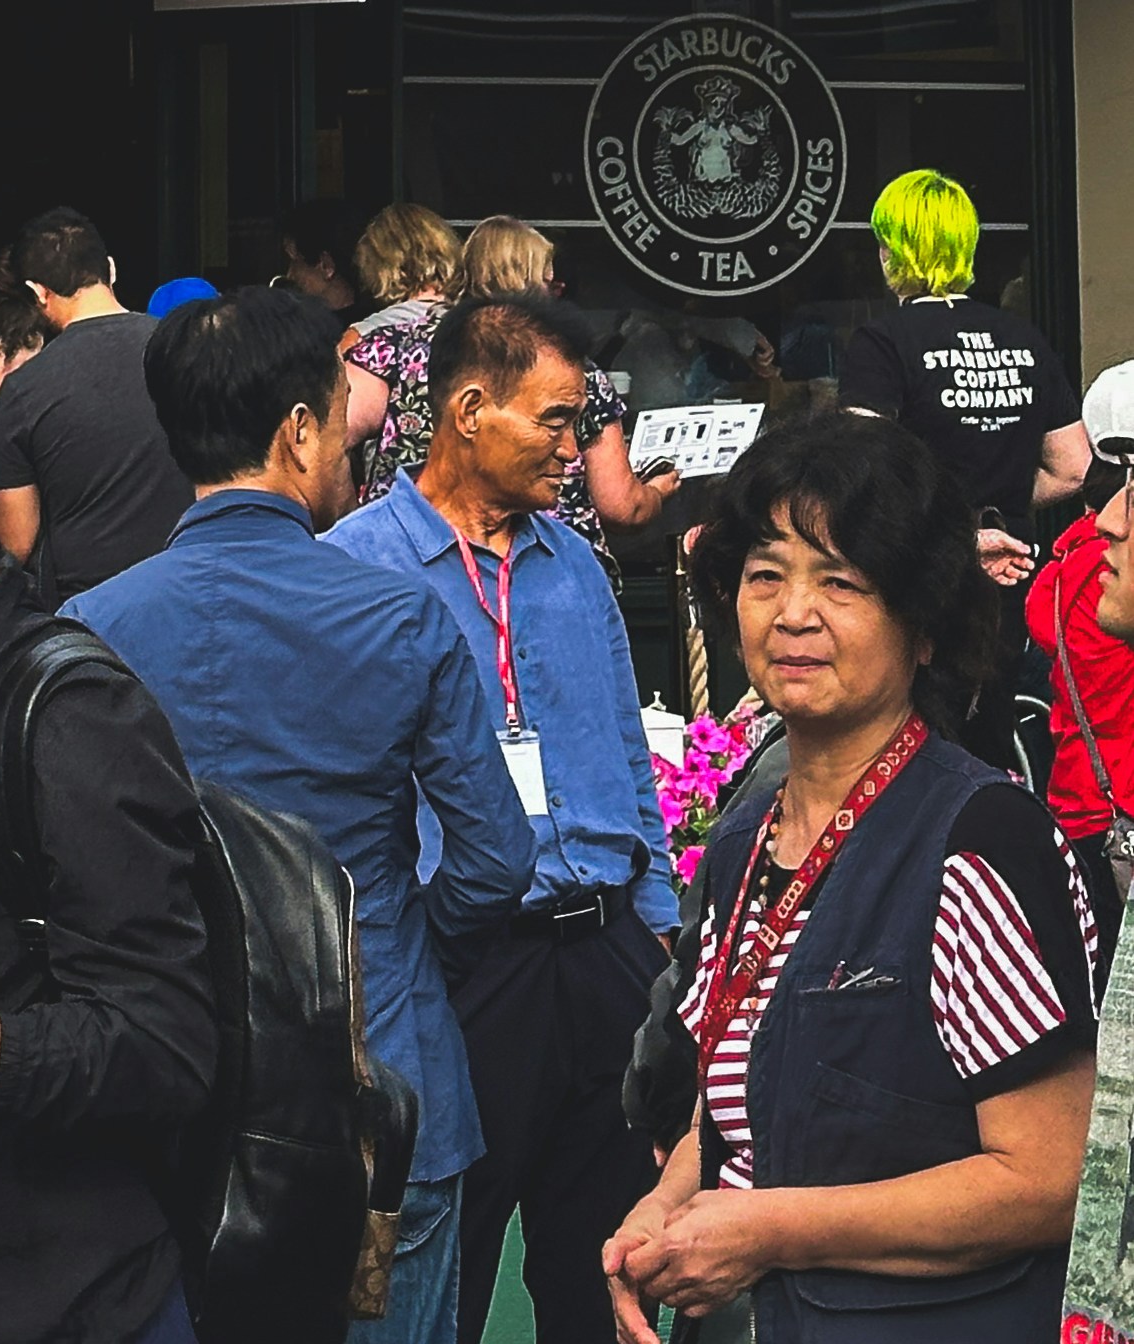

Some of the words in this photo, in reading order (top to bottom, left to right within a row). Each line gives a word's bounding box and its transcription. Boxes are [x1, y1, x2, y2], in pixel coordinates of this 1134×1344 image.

[633, 27, 797, 84] STARBUCKS
[596, 136, 661, 253] COFFEE
[786, 137, 834, 240] SPICES
[698, 250, 756, 282] TEA
[956, 331, 995, 350] THE
[922, 349, 1035, 370] STARBUCKS
[953, 368, 1022, 389] COFFEE
[940, 387, 1034, 409] COMPANY
